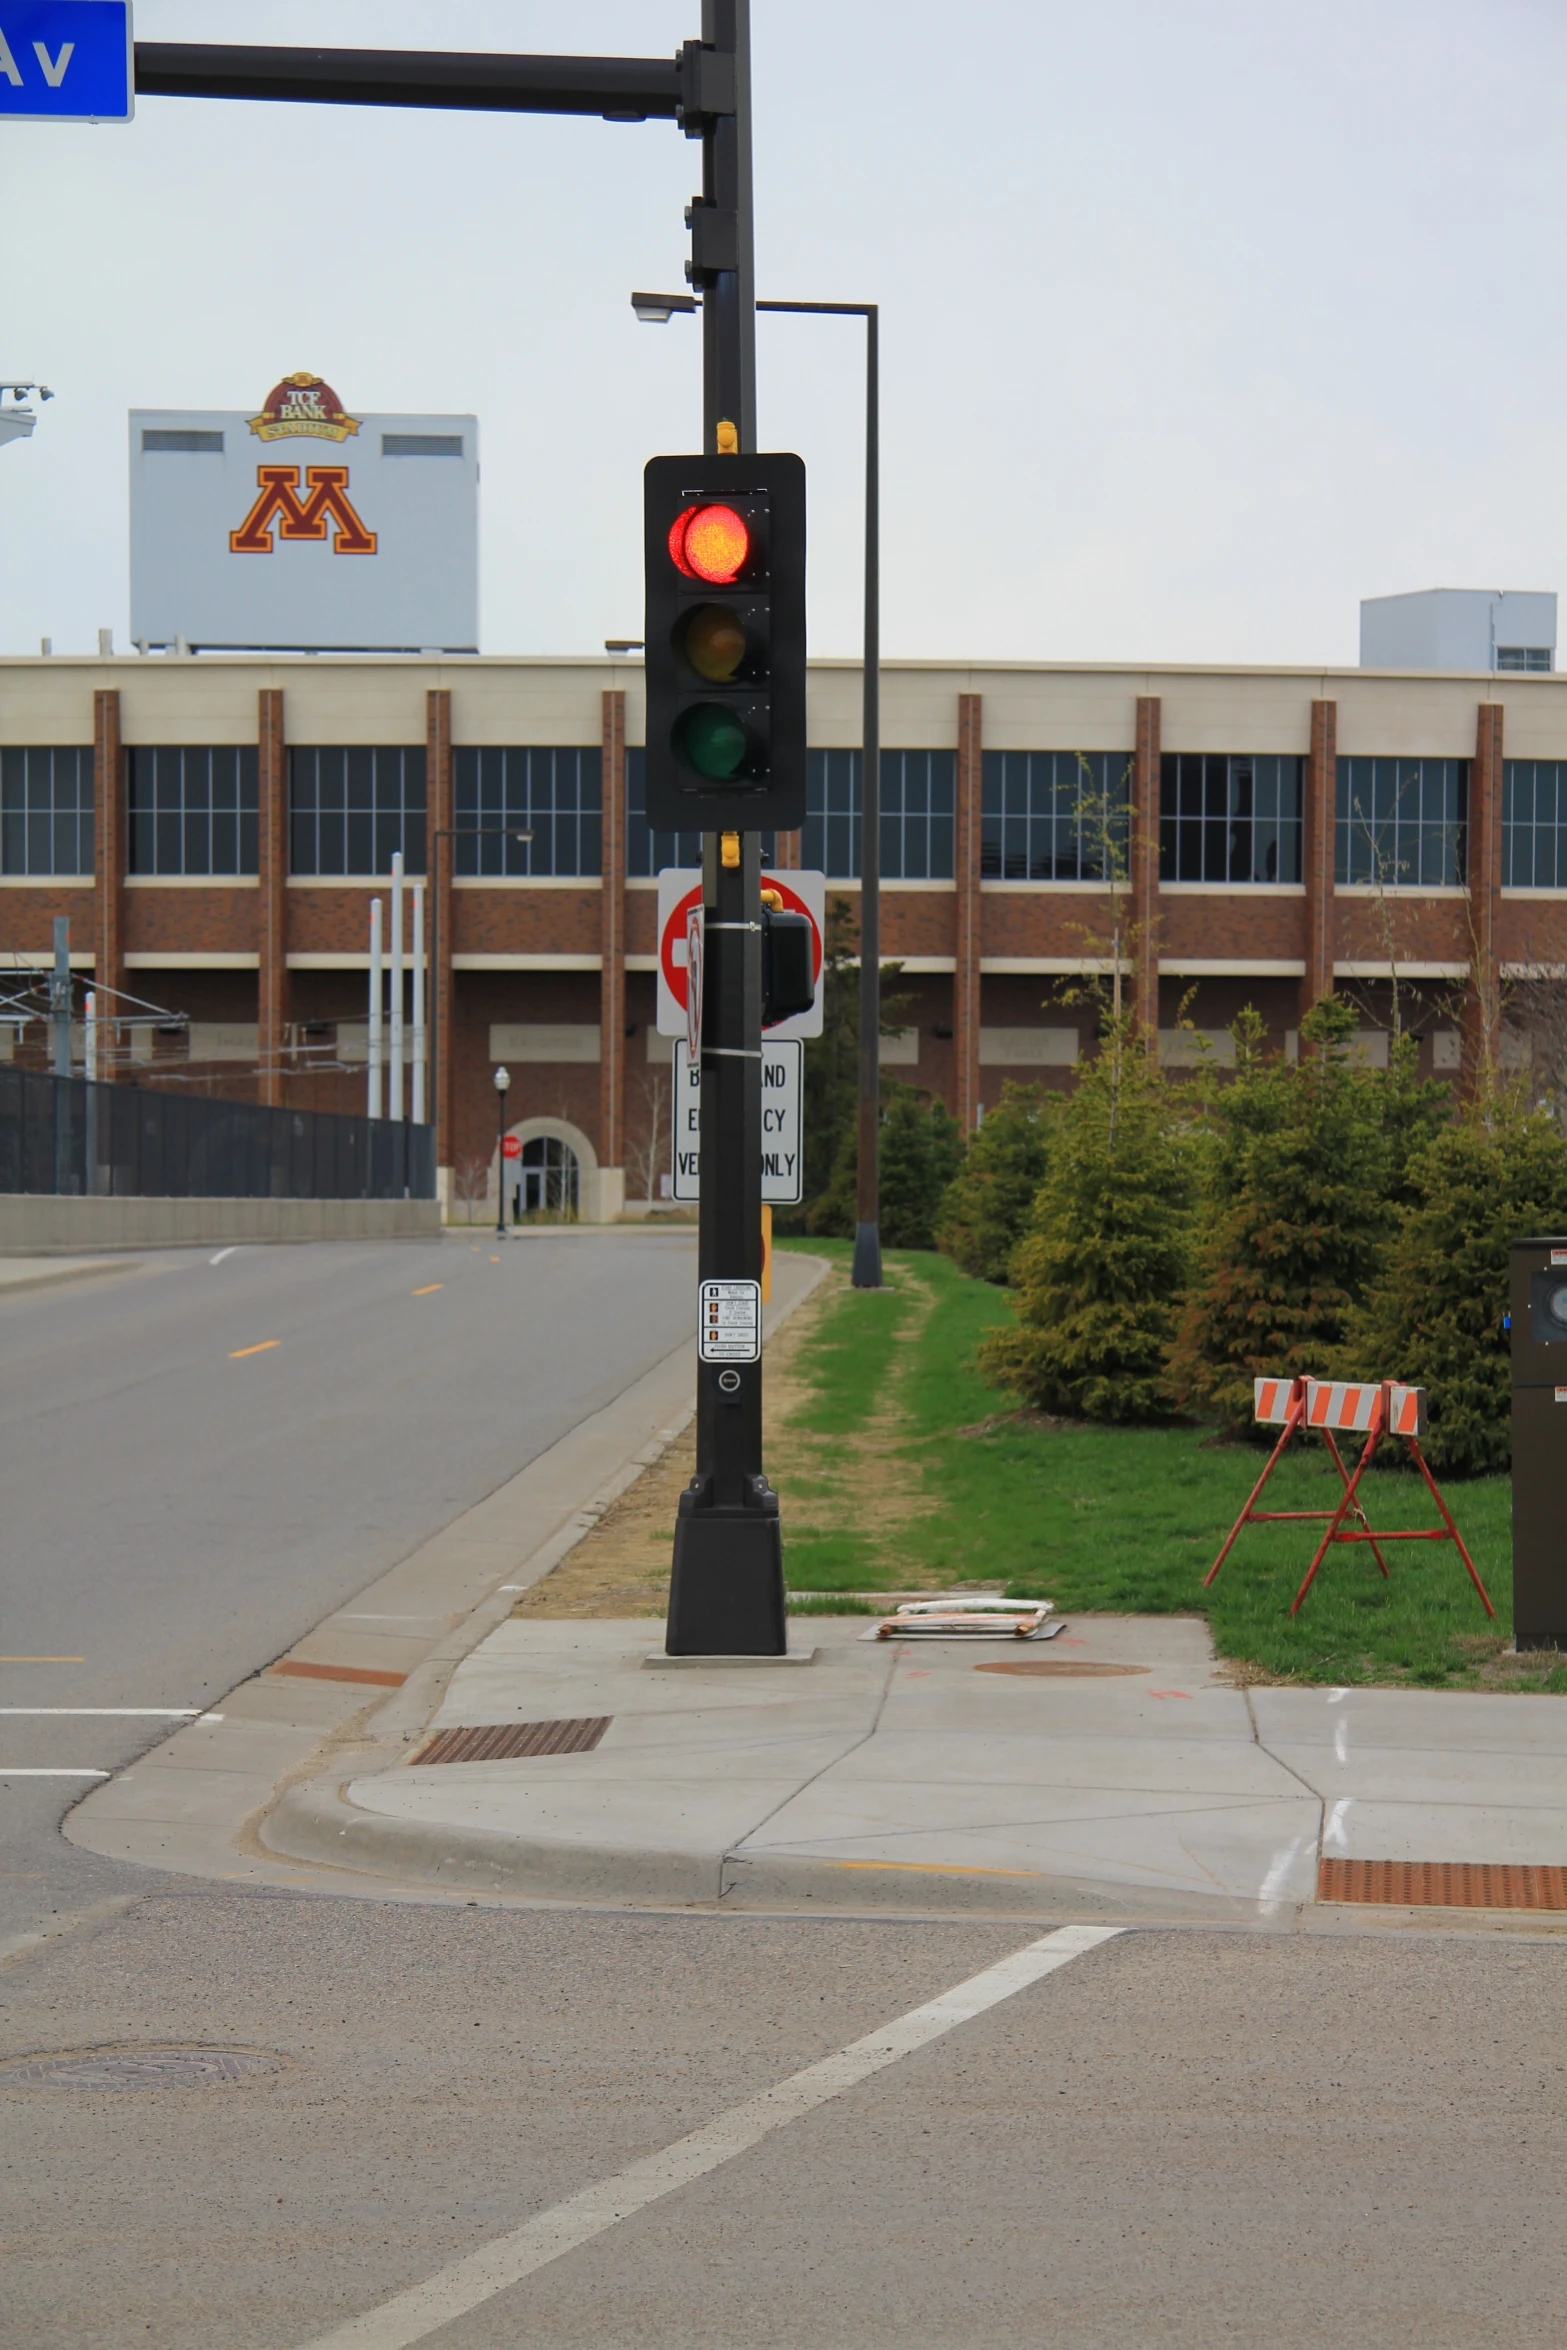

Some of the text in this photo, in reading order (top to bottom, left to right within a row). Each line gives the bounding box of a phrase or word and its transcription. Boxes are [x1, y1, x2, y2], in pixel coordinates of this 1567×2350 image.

[287, 391, 321, 405] TCF
[280, 404, 328, 420] BANK
[229, 465, 378, 554] M
[761, 1064, 786, 1088] ND
